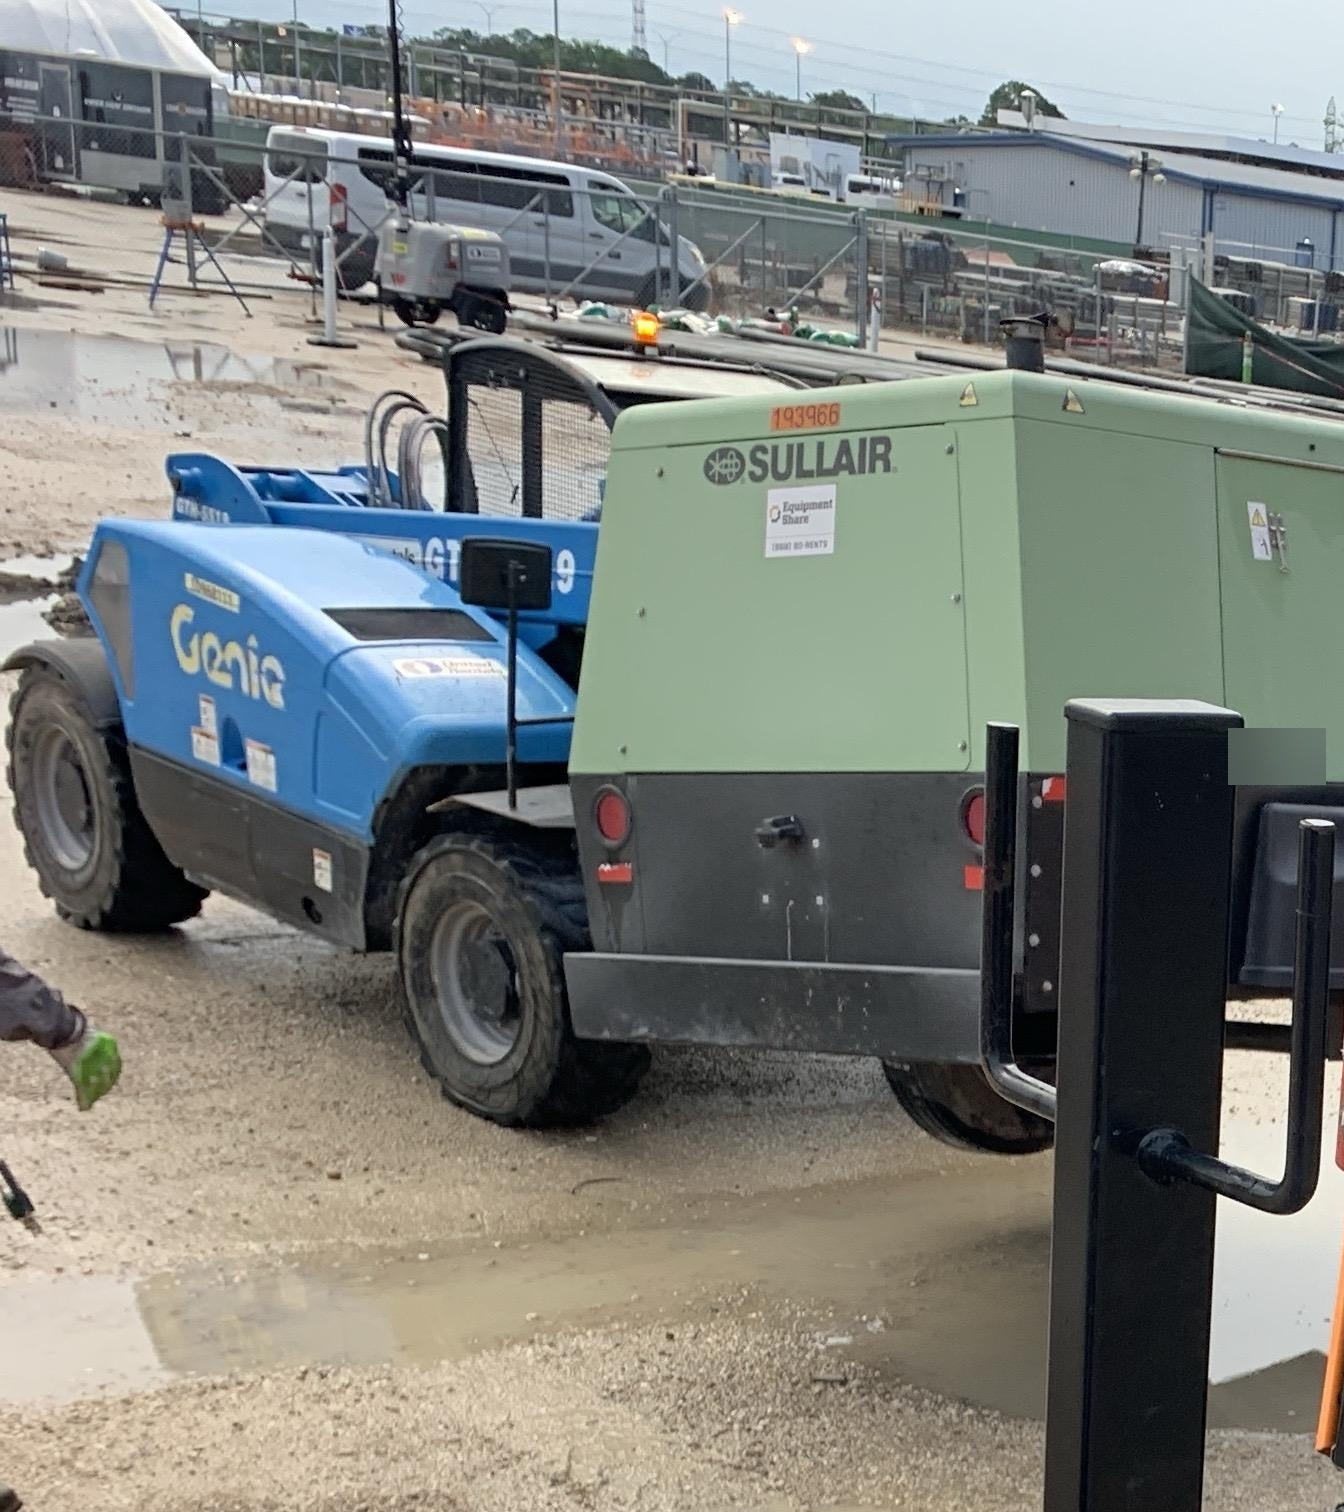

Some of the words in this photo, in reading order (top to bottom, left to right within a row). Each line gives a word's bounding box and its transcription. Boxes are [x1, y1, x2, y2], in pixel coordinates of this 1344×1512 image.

[772, 403, 840, 429] 193966
[748, 436, 893, 483] SULLAIR
[782, 499, 833, 514] Equipment
[782, 514, 809, 525] Share
[170, 603, 286, 710] Genie
